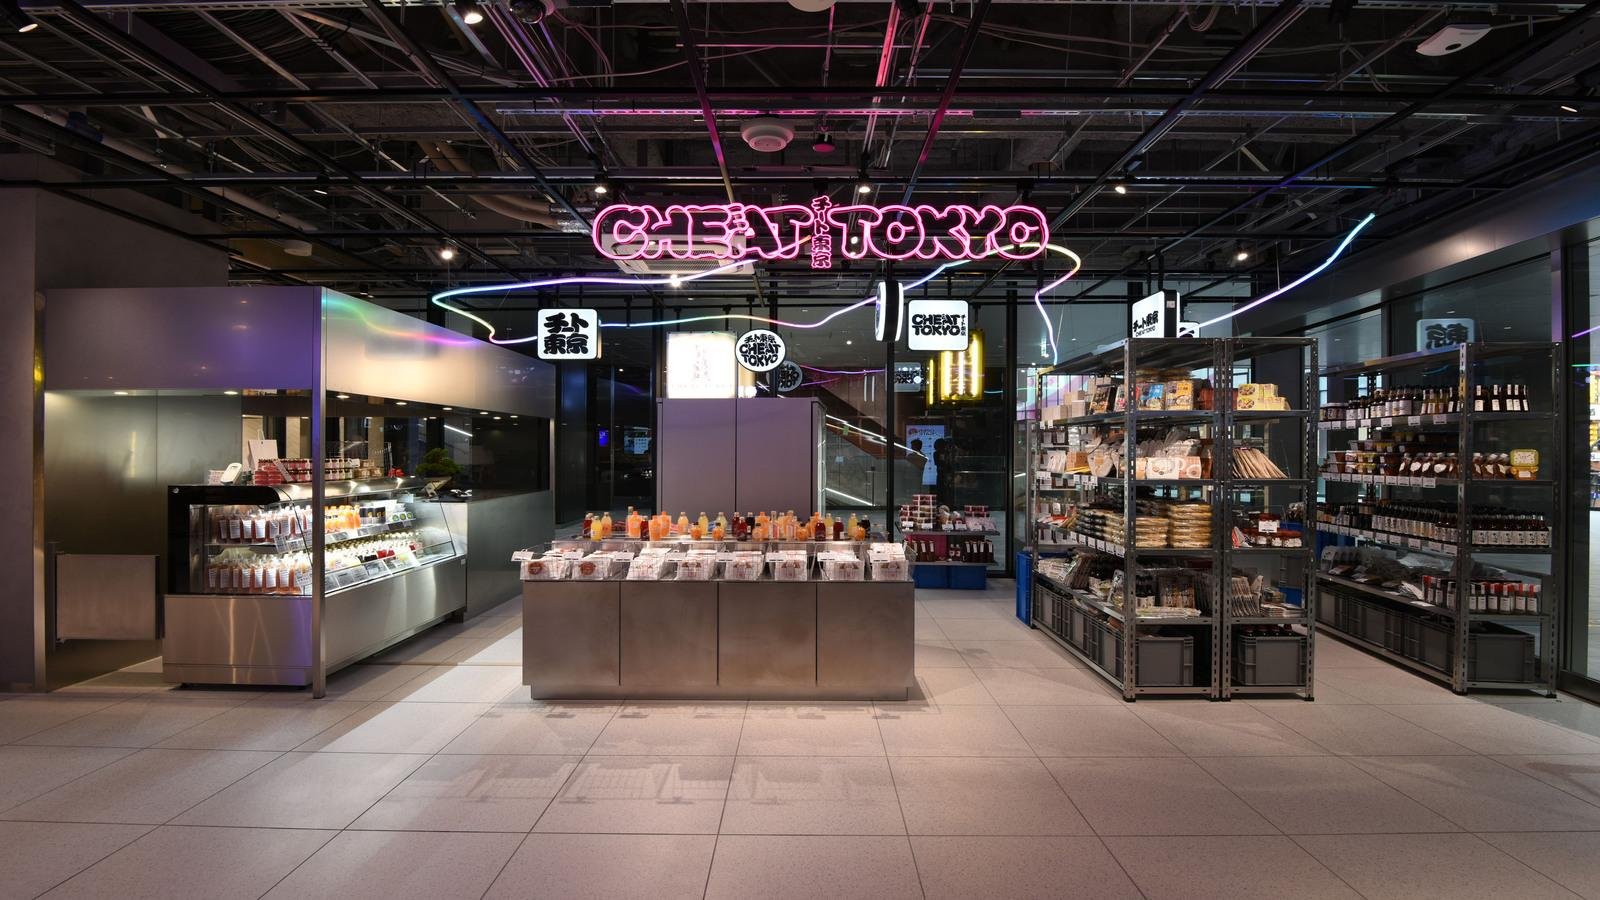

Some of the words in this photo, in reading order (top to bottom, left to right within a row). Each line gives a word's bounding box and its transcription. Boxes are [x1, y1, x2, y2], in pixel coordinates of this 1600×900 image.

[592, 203, 815, 259] CHEAT
[827, 204, 1049, 259] TOKYO
[811, 194, 832, 269] チート東京
[543, 312, 589, 333] チート
[912, 314, 960, 326] CHEAT
[912, 325, 960, 336] TOKYO
[543, 333, 589, 354] 東京
[739, 342, 781, 355] CHEAT
[741, 354, 777, 366] TOKYO
